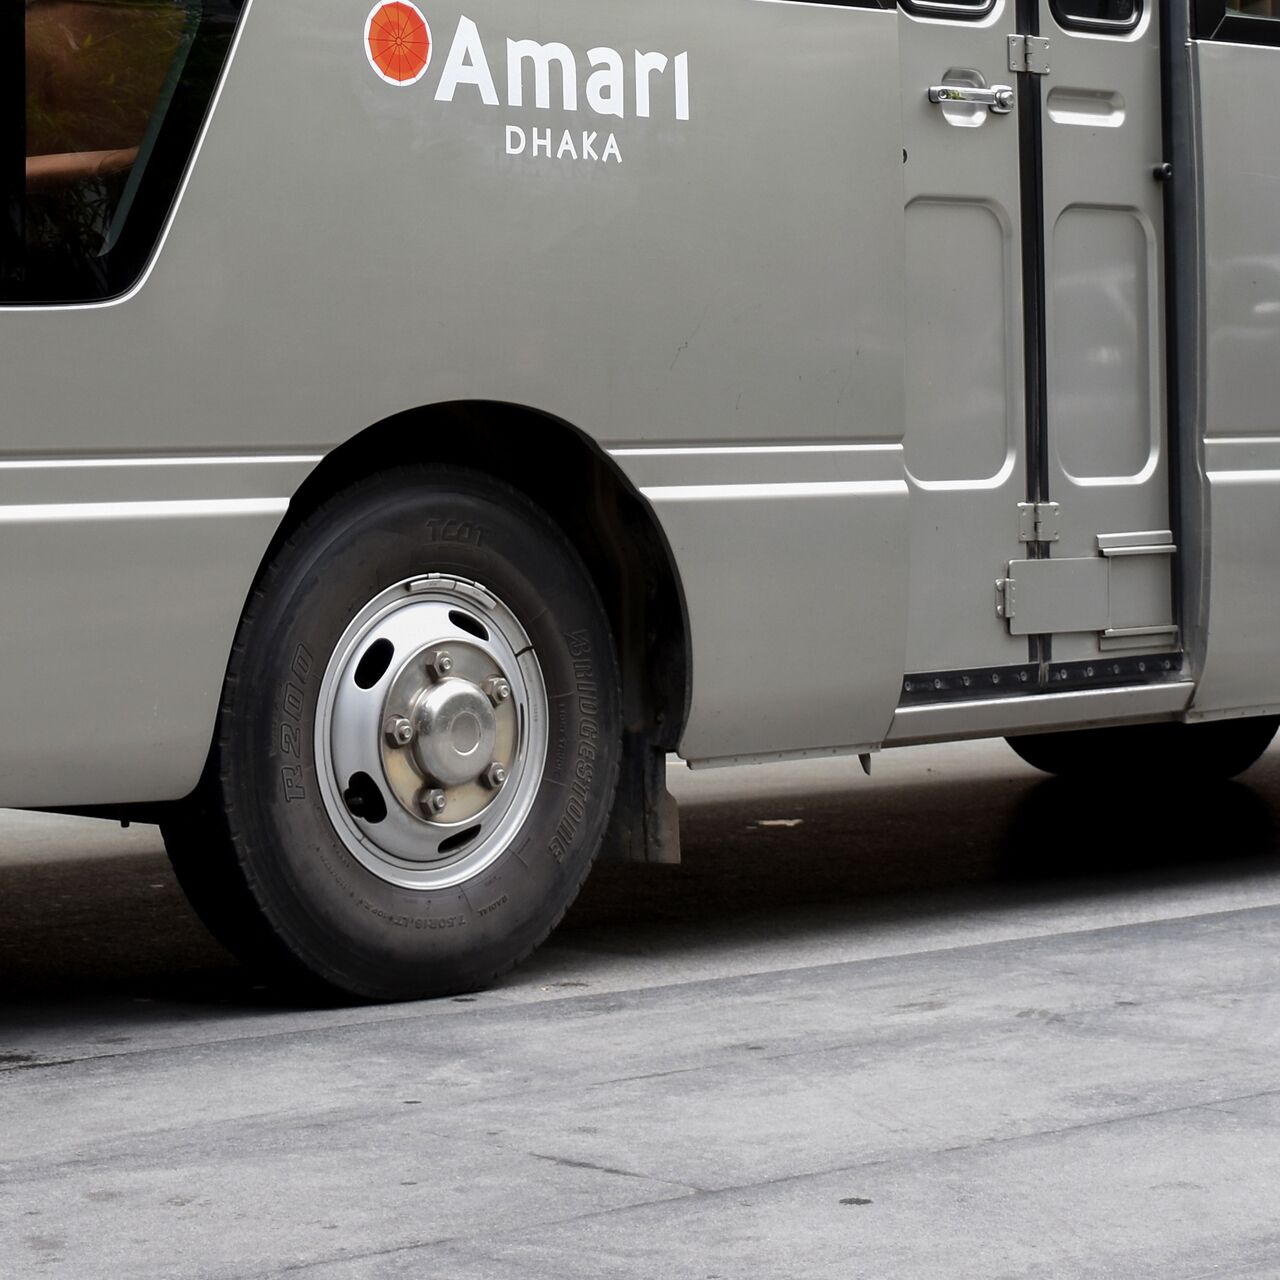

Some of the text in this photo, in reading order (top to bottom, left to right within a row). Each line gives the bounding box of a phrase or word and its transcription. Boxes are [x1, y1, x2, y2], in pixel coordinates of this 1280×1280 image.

[506, 125, 622, 162] DHAKA
[280, 641, 314, 802] R200
[549, 628, 599, 864] BRIDGESTONE
[477, 895, 508, 917] RADIAL
